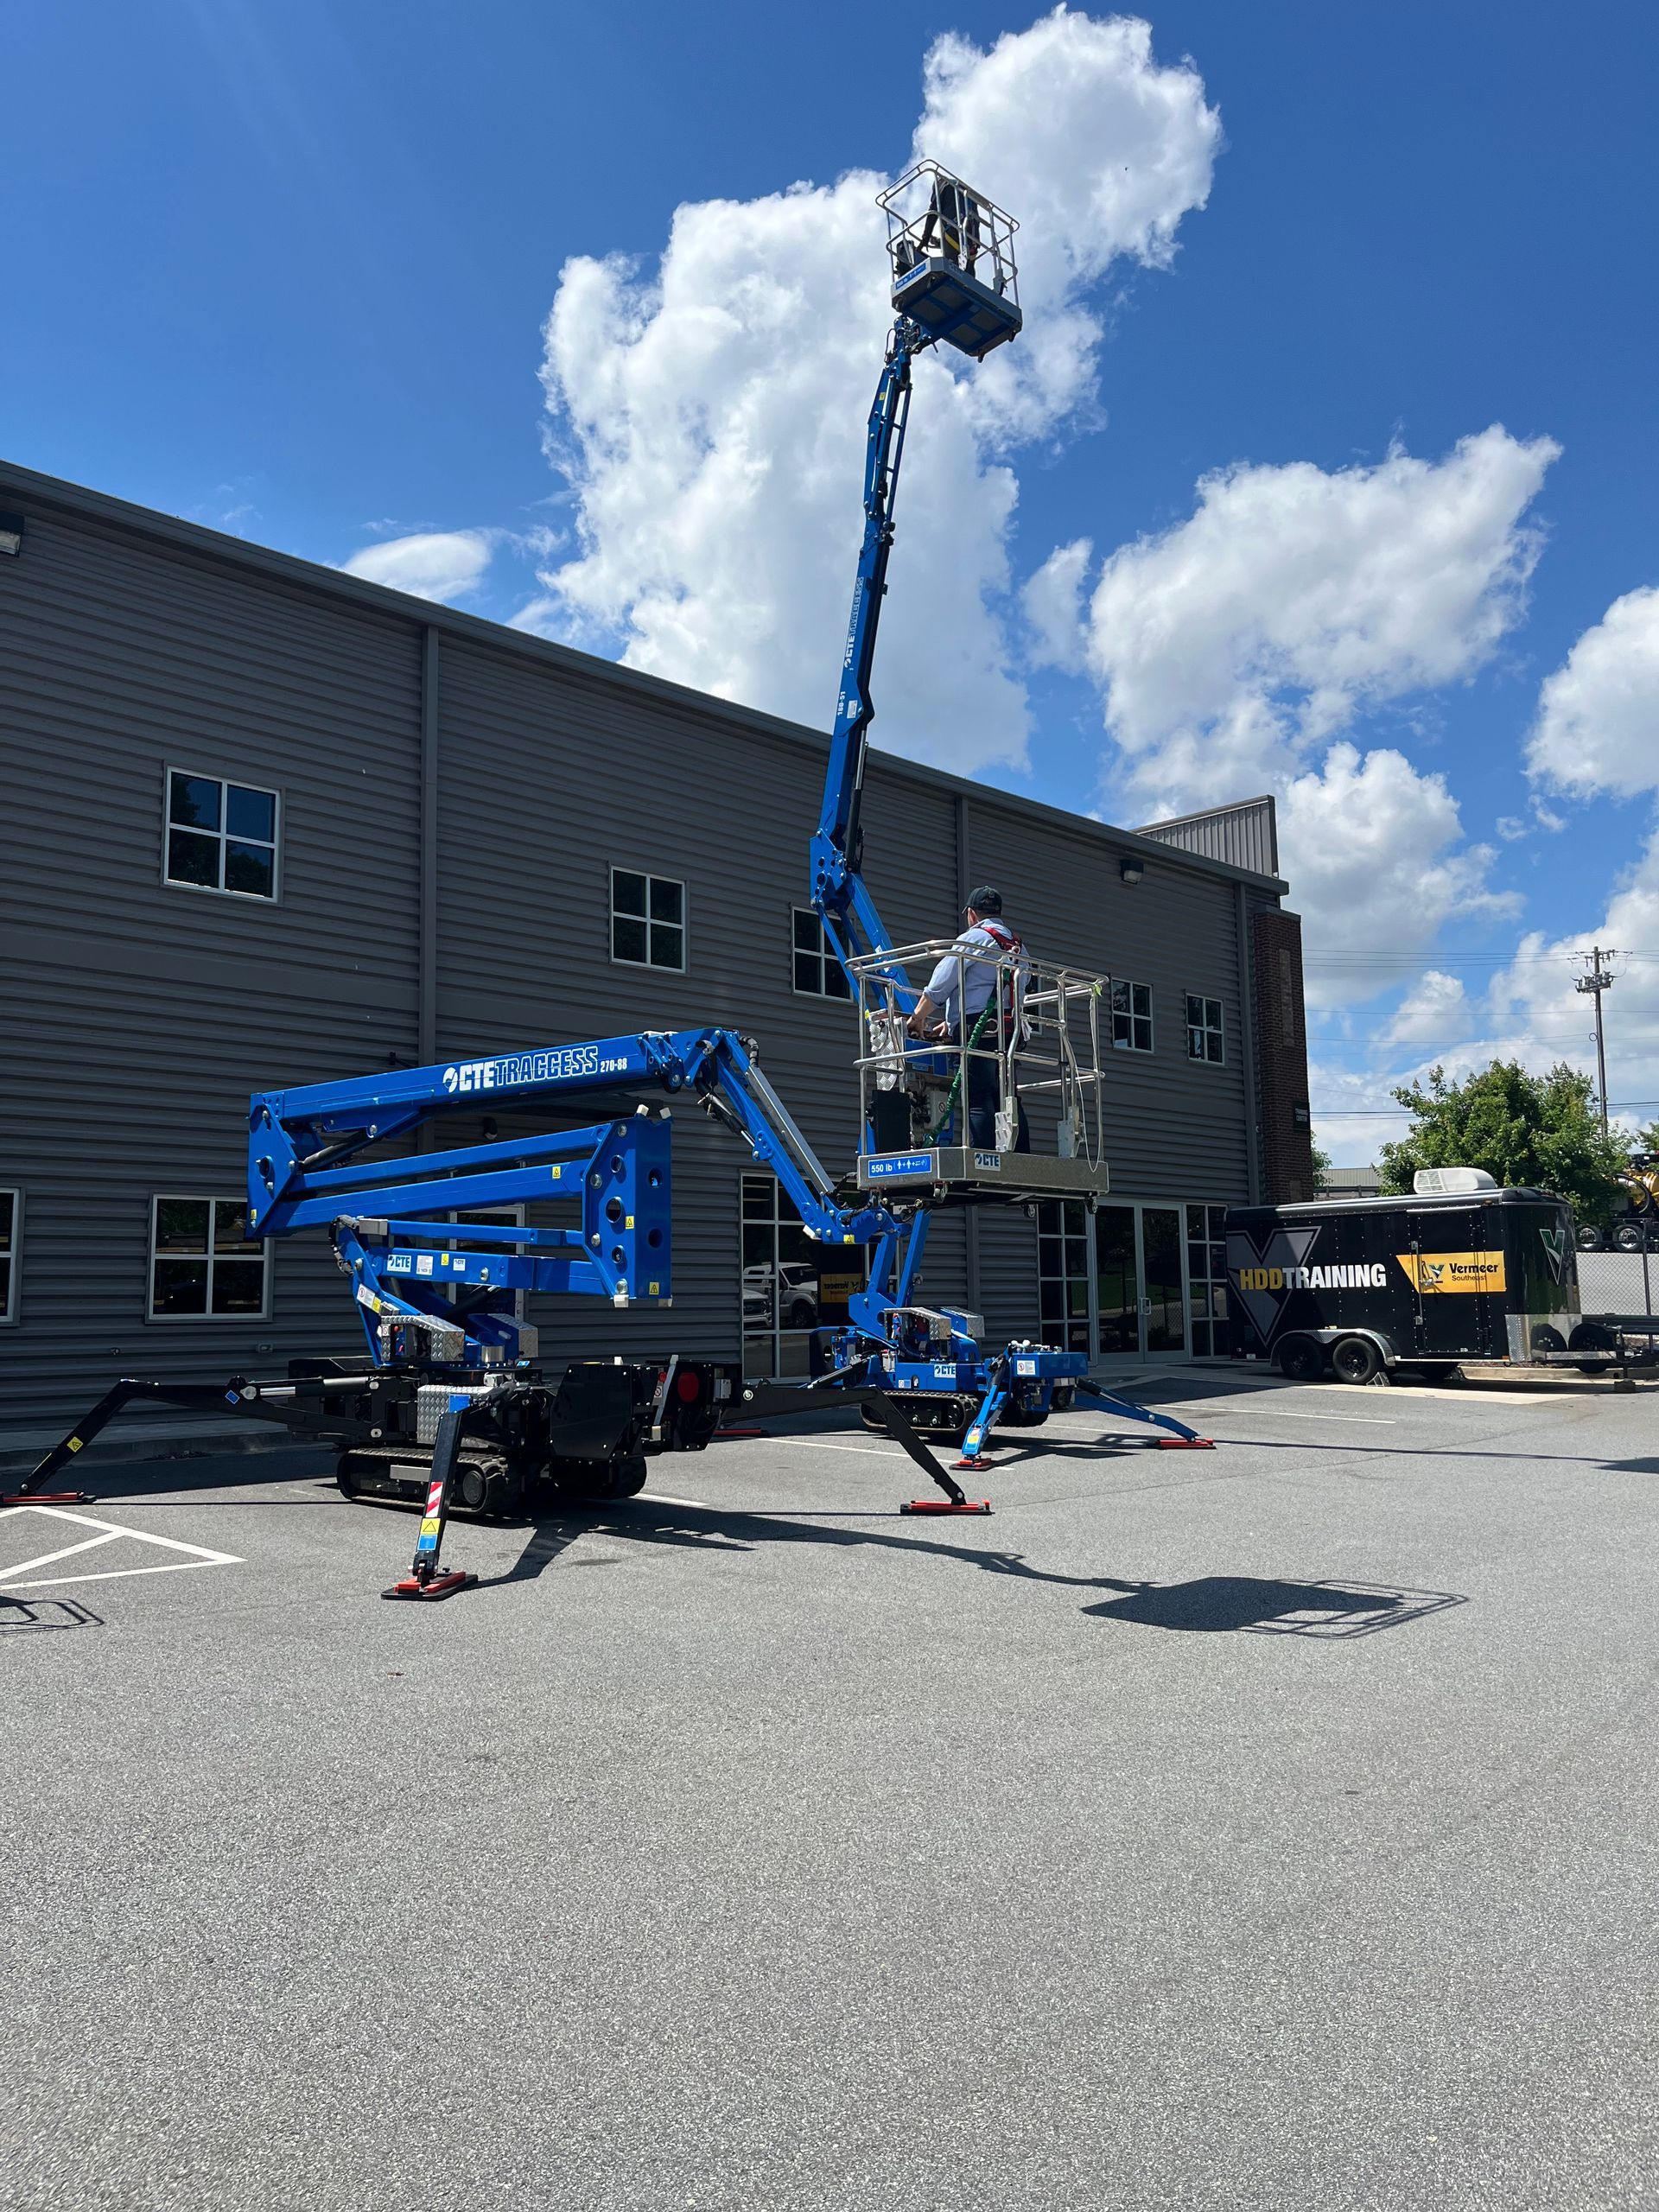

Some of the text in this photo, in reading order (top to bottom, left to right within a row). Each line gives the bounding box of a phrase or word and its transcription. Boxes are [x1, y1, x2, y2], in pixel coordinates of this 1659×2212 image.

[601, 1057, 627, 1072] 270-88
[983, 1154, 1000, 1166] CTE
[871, 1163, 893, 1173] 550 lb
[395, 1255, 410, 1268] CTE
[1449, 1262, 1498, 1274] Vermeer
[941, 1364, 956, 1375] CTE
